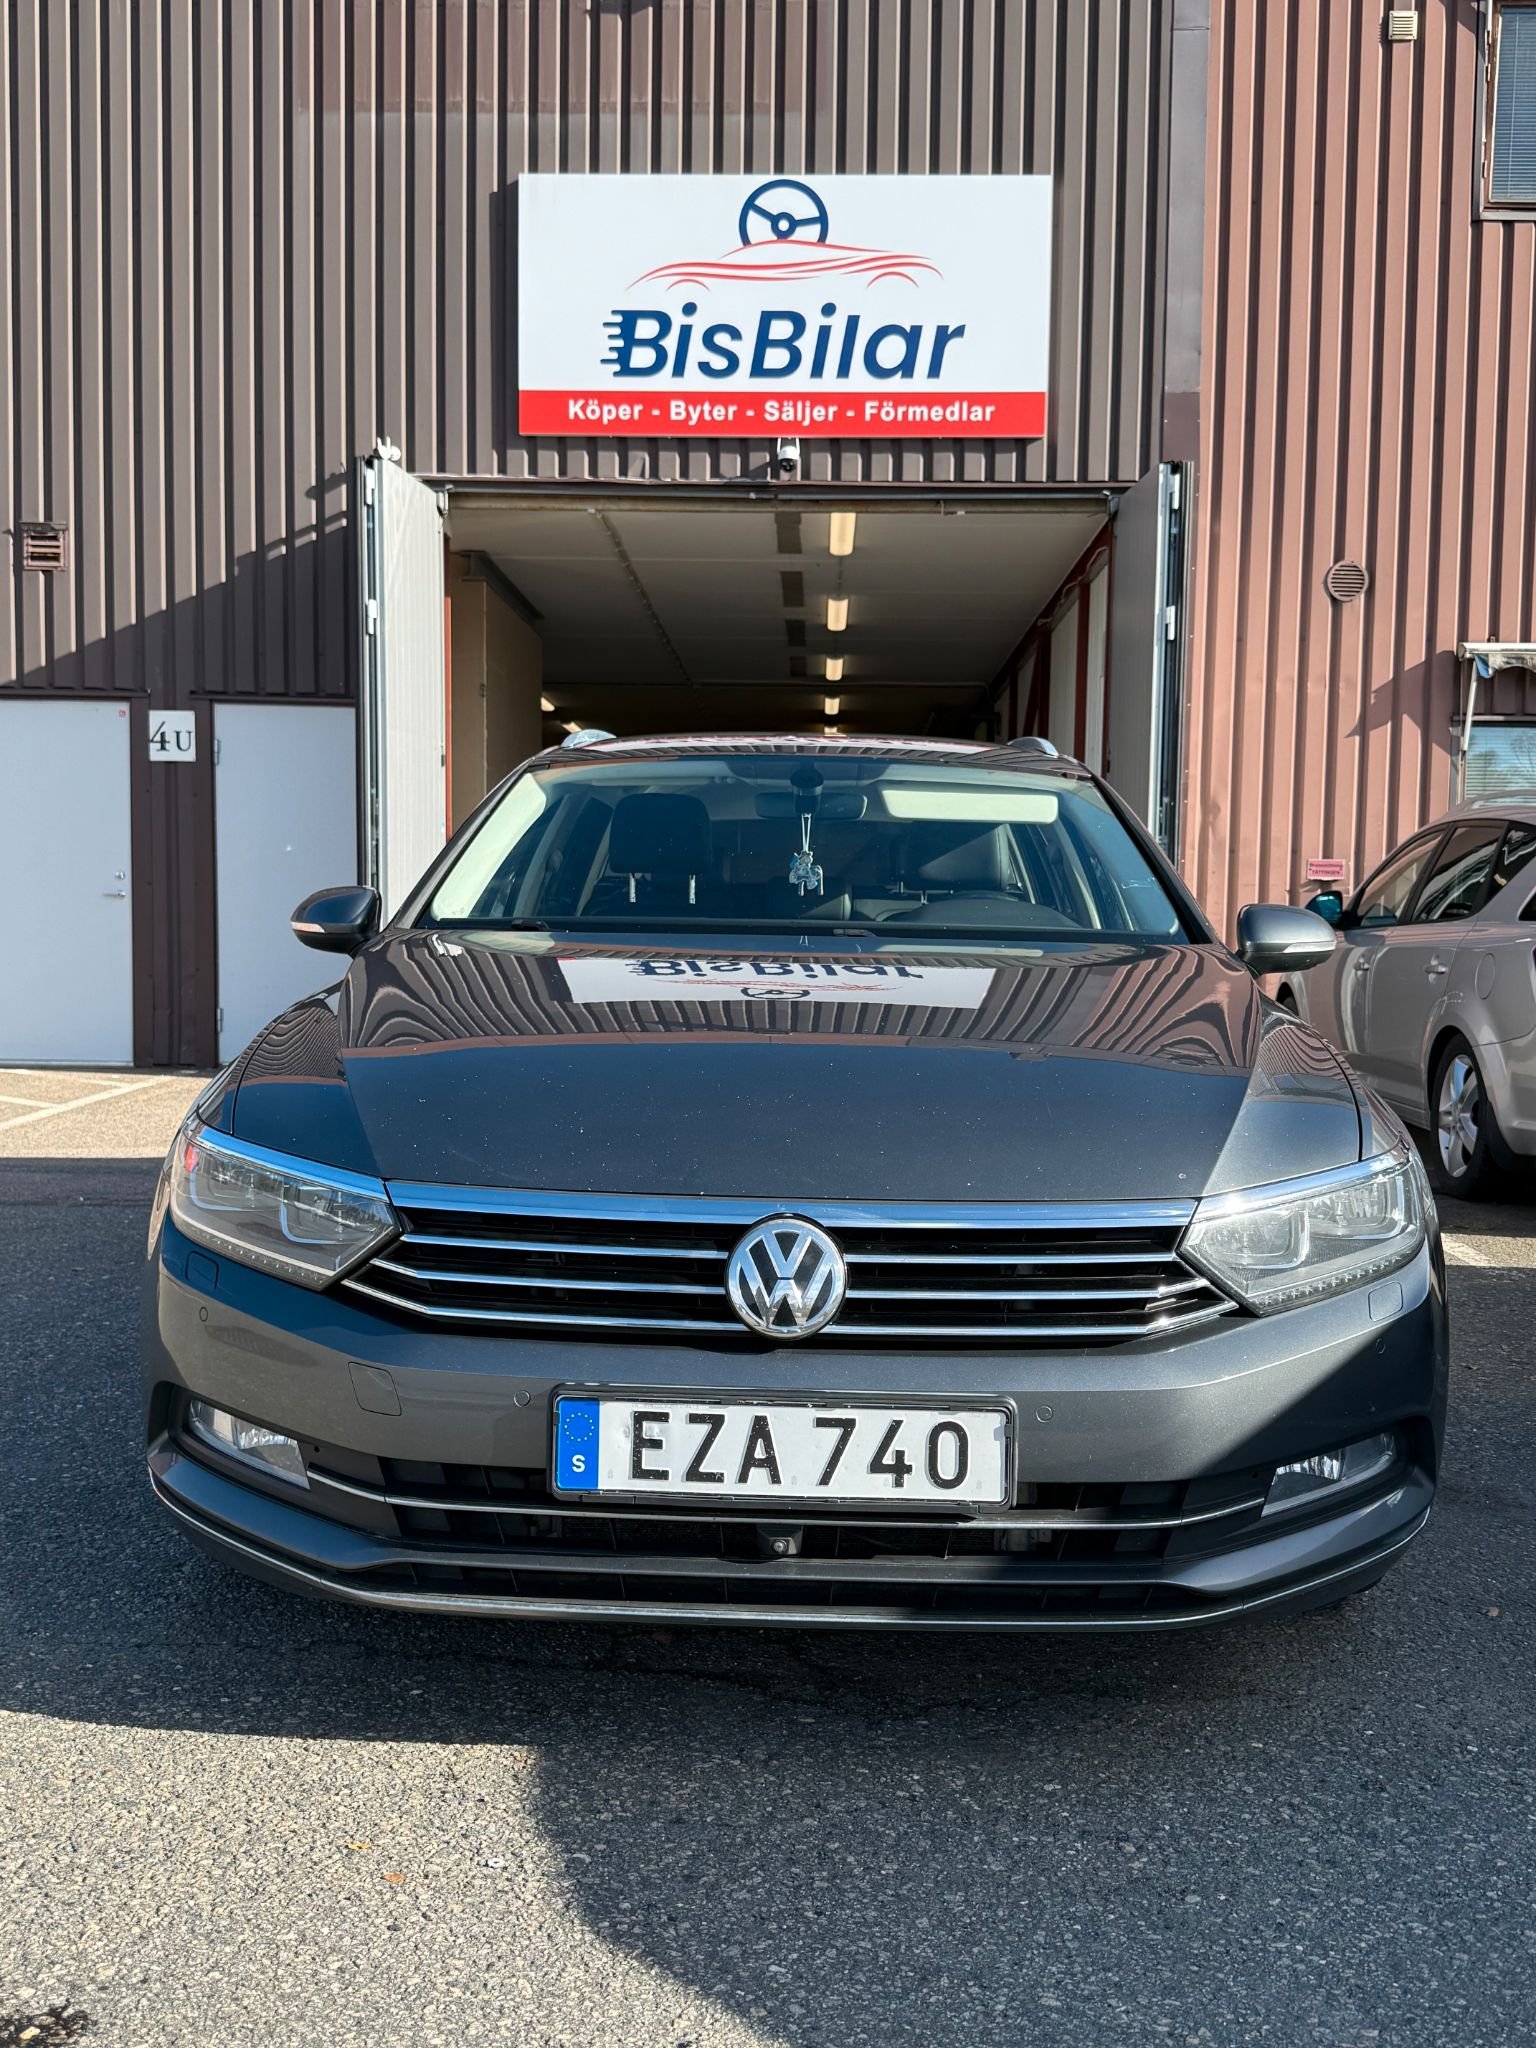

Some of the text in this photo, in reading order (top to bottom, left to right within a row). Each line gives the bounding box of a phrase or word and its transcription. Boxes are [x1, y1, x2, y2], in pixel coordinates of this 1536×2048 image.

[599, 302, 966, 380] BisBilar
[568, 399, 645, 426] Köper
[670, 399, 738, 426] Byter
[763, 400, 838, 427] Säljer
[864, 400, 996, 422] Förmedlar
[571, 1410, 970, 1490] S EZA 740
